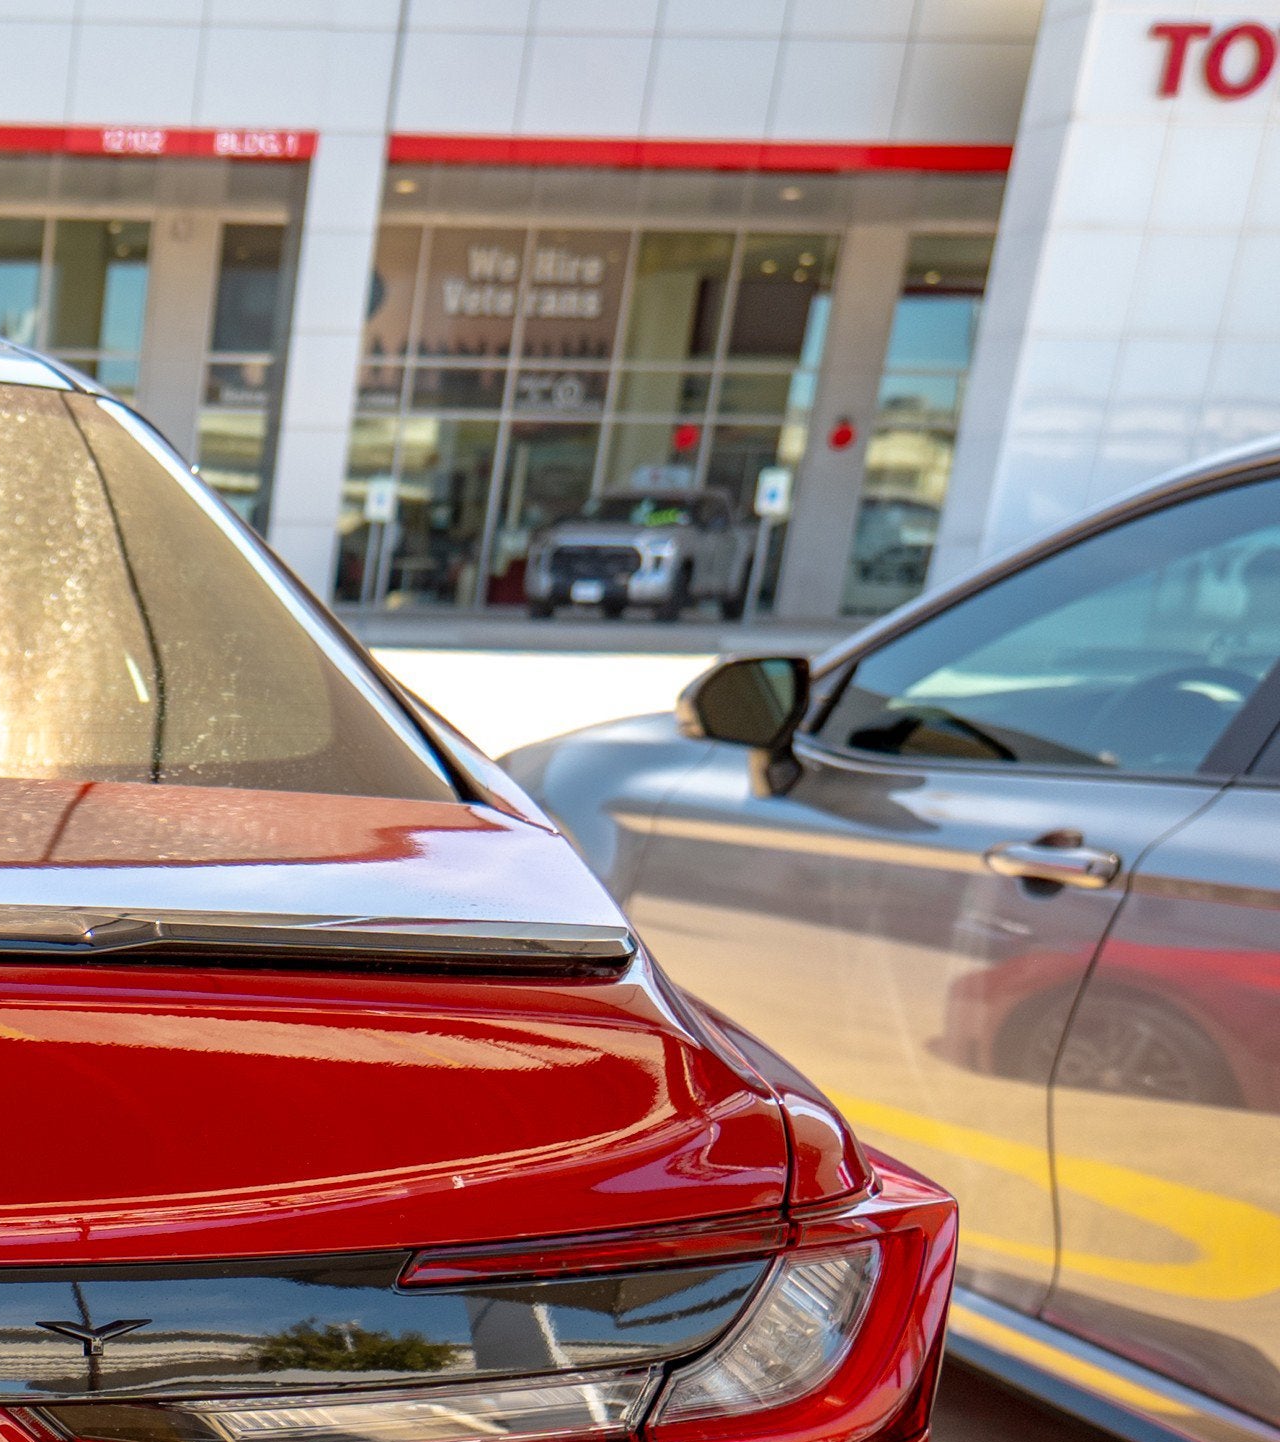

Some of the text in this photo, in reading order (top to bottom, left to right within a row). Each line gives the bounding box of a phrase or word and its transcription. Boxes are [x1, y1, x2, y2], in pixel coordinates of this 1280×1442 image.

[467, 246, 604, 284] We Hire
[443, 276, 602, 319] Veterans
